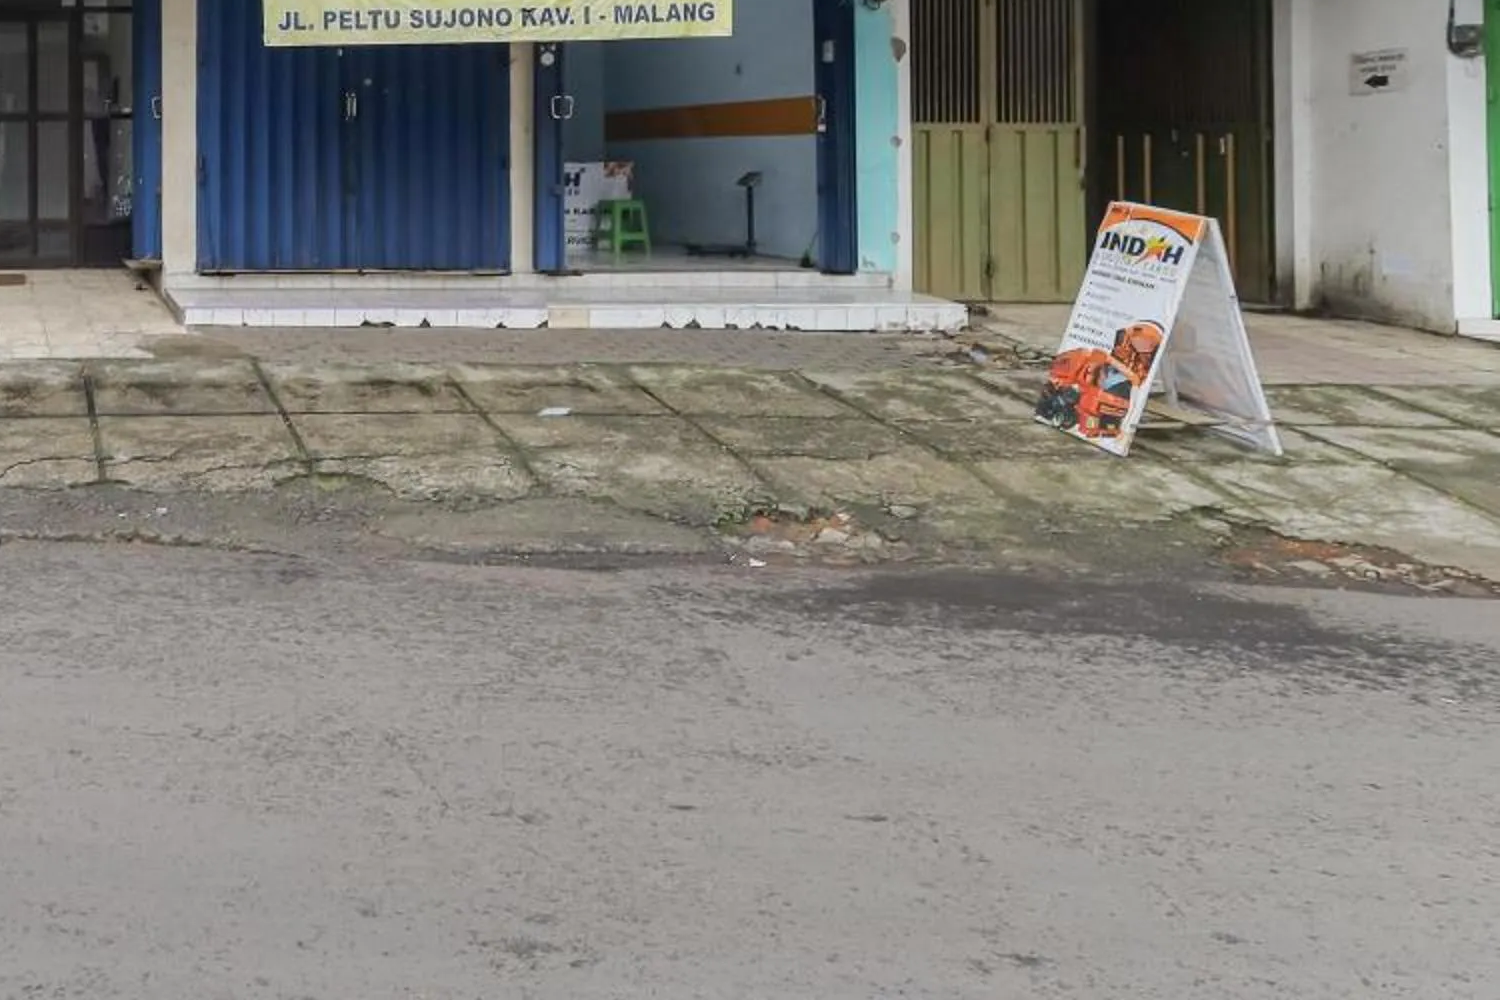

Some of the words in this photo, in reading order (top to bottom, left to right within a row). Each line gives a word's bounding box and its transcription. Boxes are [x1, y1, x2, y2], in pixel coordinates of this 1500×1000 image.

[278, 10, 314, 31] JL.
[323, 8, 401, 30] PELTU
[409, 7, 512, 29] SUJONO
[521, 7, 575, 27] KAV.
[614, 3, 716, 24] MALANG
